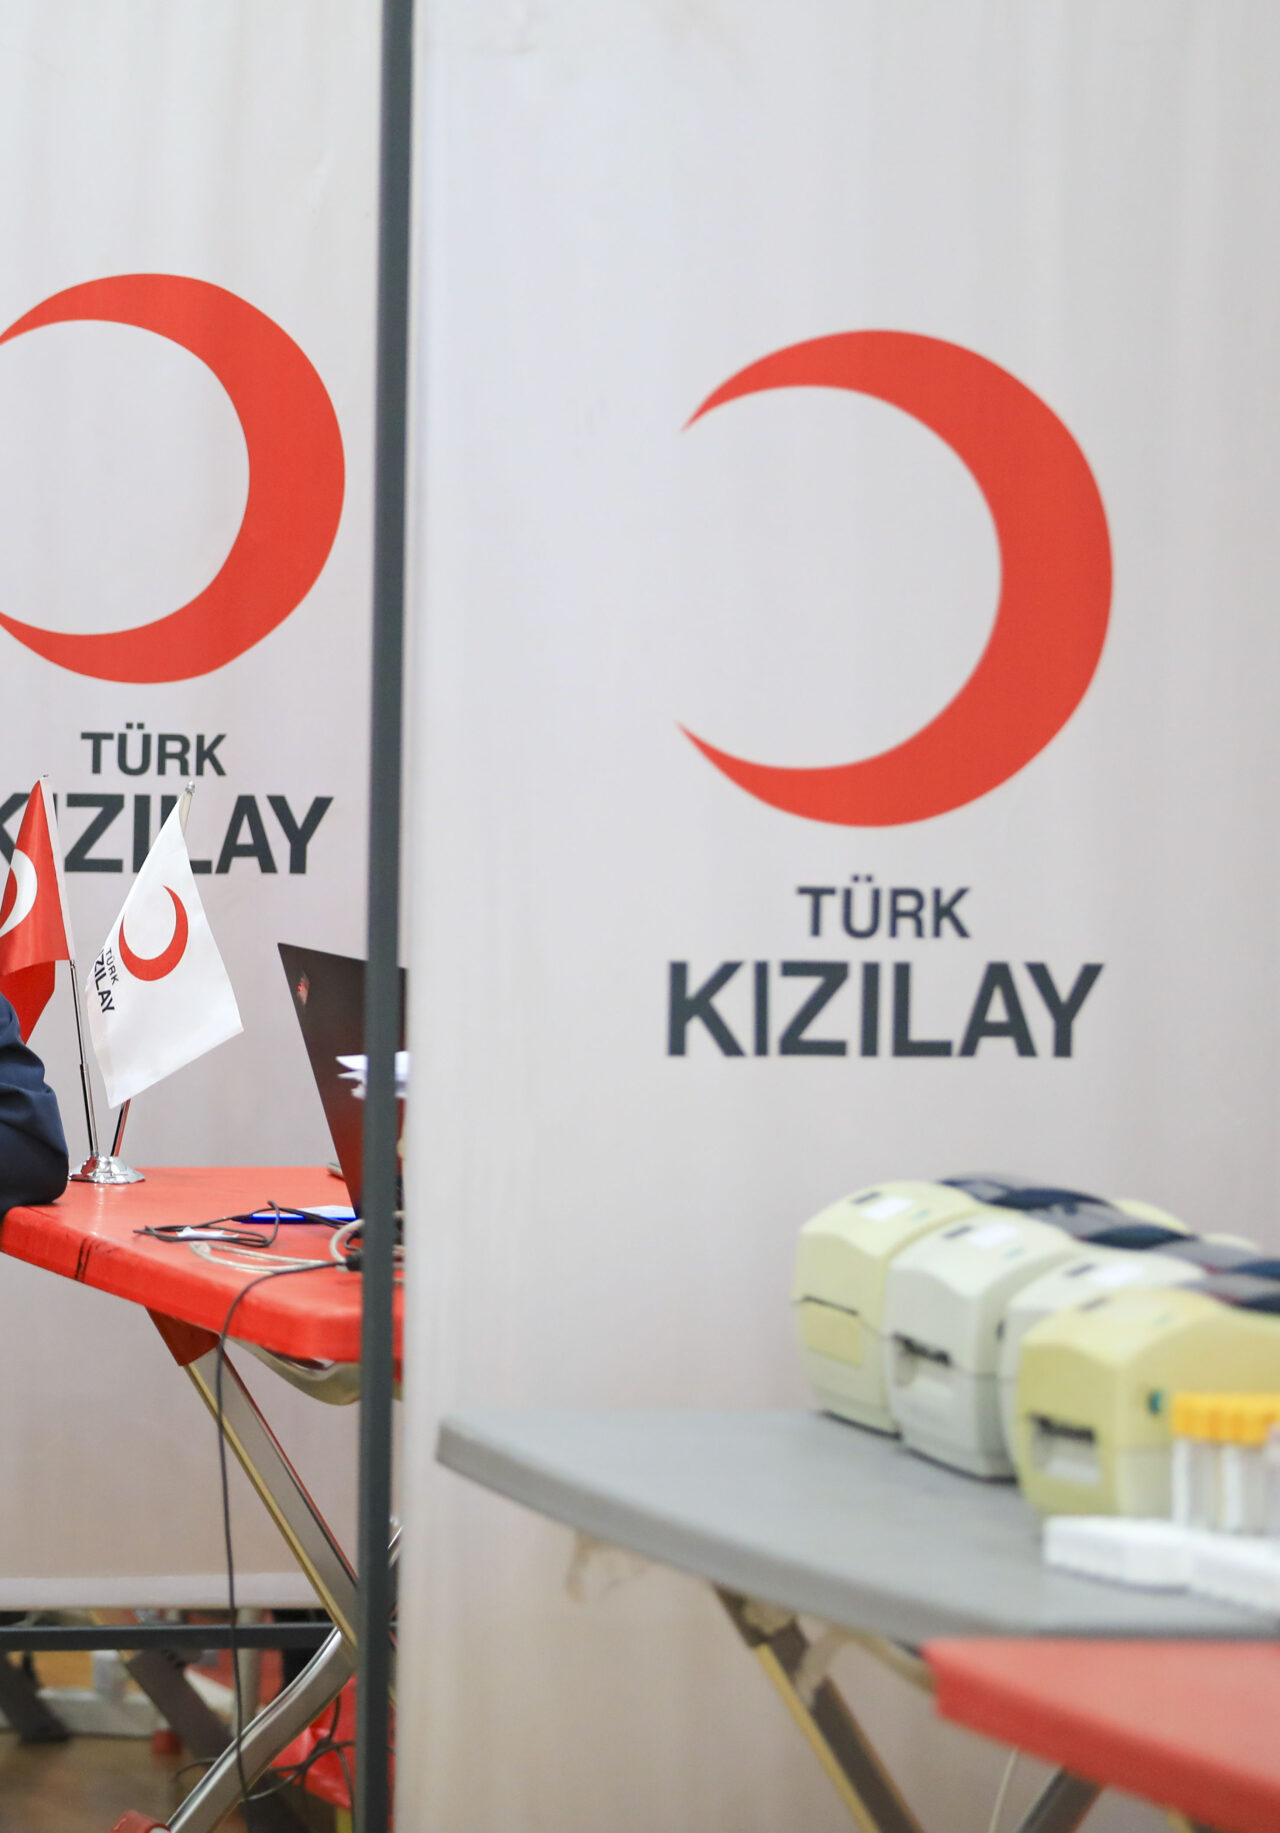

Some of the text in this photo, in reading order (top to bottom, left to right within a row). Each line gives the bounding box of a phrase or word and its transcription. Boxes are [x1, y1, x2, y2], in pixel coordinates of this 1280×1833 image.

[81, 722, 227, 777] TÜRK
[796, 875, 971, 940] TÜRK
[94, 952, 116, 1014] ZILAY
[666, 960, 1105, 1059] KIZILAY
